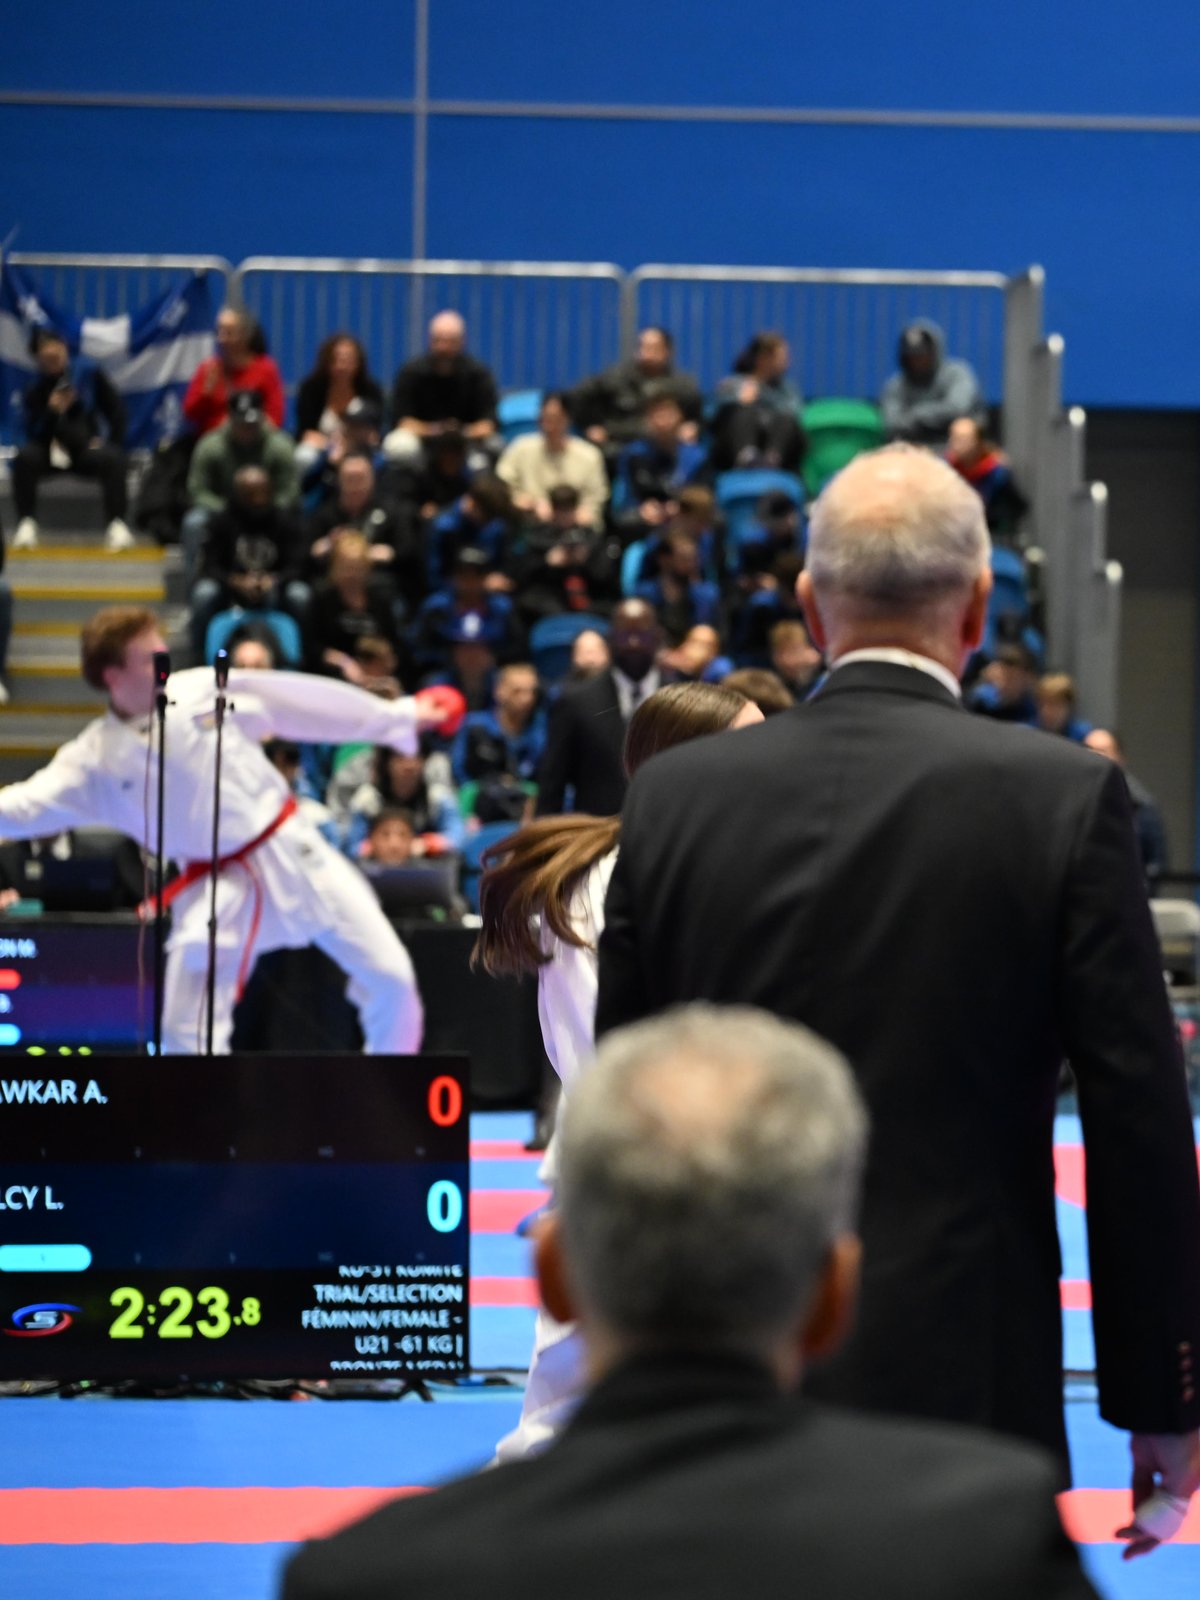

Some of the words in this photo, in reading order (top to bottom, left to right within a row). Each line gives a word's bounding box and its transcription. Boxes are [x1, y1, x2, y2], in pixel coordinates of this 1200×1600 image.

[0, 1079, 78, 1104] WKAR
[83, 1079, 108, 1104] A.
[427, 1075, 462, 1127] 0
[45, 1185, 64, 1210] L.
[427, 1180, 462, 1232] 0
[313, 1284, 463, 1304] TRIAL/SELECTION
[301, 1307, 449, 1330] FÉMININ/FEMALE
[354, 1335, 389, 1354] U21
[393, 1335, 422, 1354] -61
[427, 1335, 453, 1354] KG
